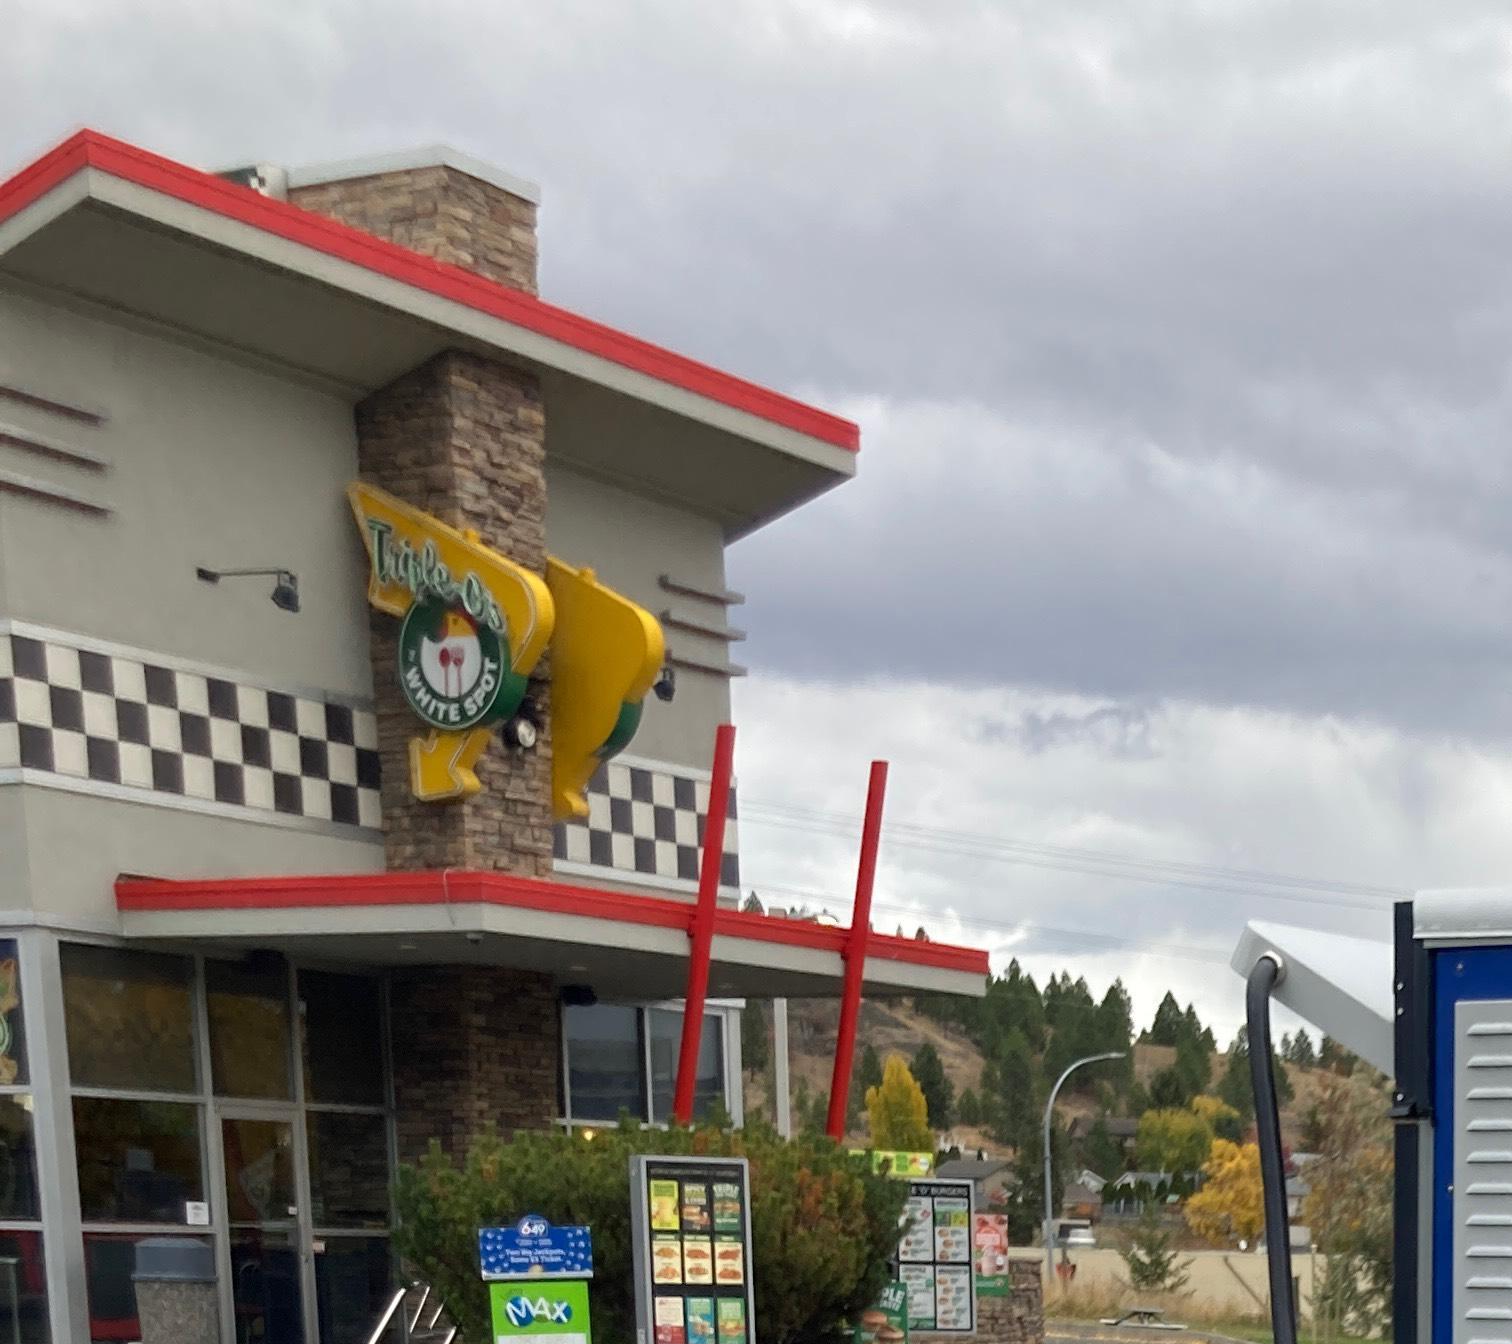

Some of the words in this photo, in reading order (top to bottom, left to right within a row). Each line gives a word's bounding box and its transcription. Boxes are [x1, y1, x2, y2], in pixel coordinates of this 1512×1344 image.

[405, 665, 462, 723] WHITE
[463, 656, 498, 716] SPOT
[505, 1296, 569, 1327] MAX
